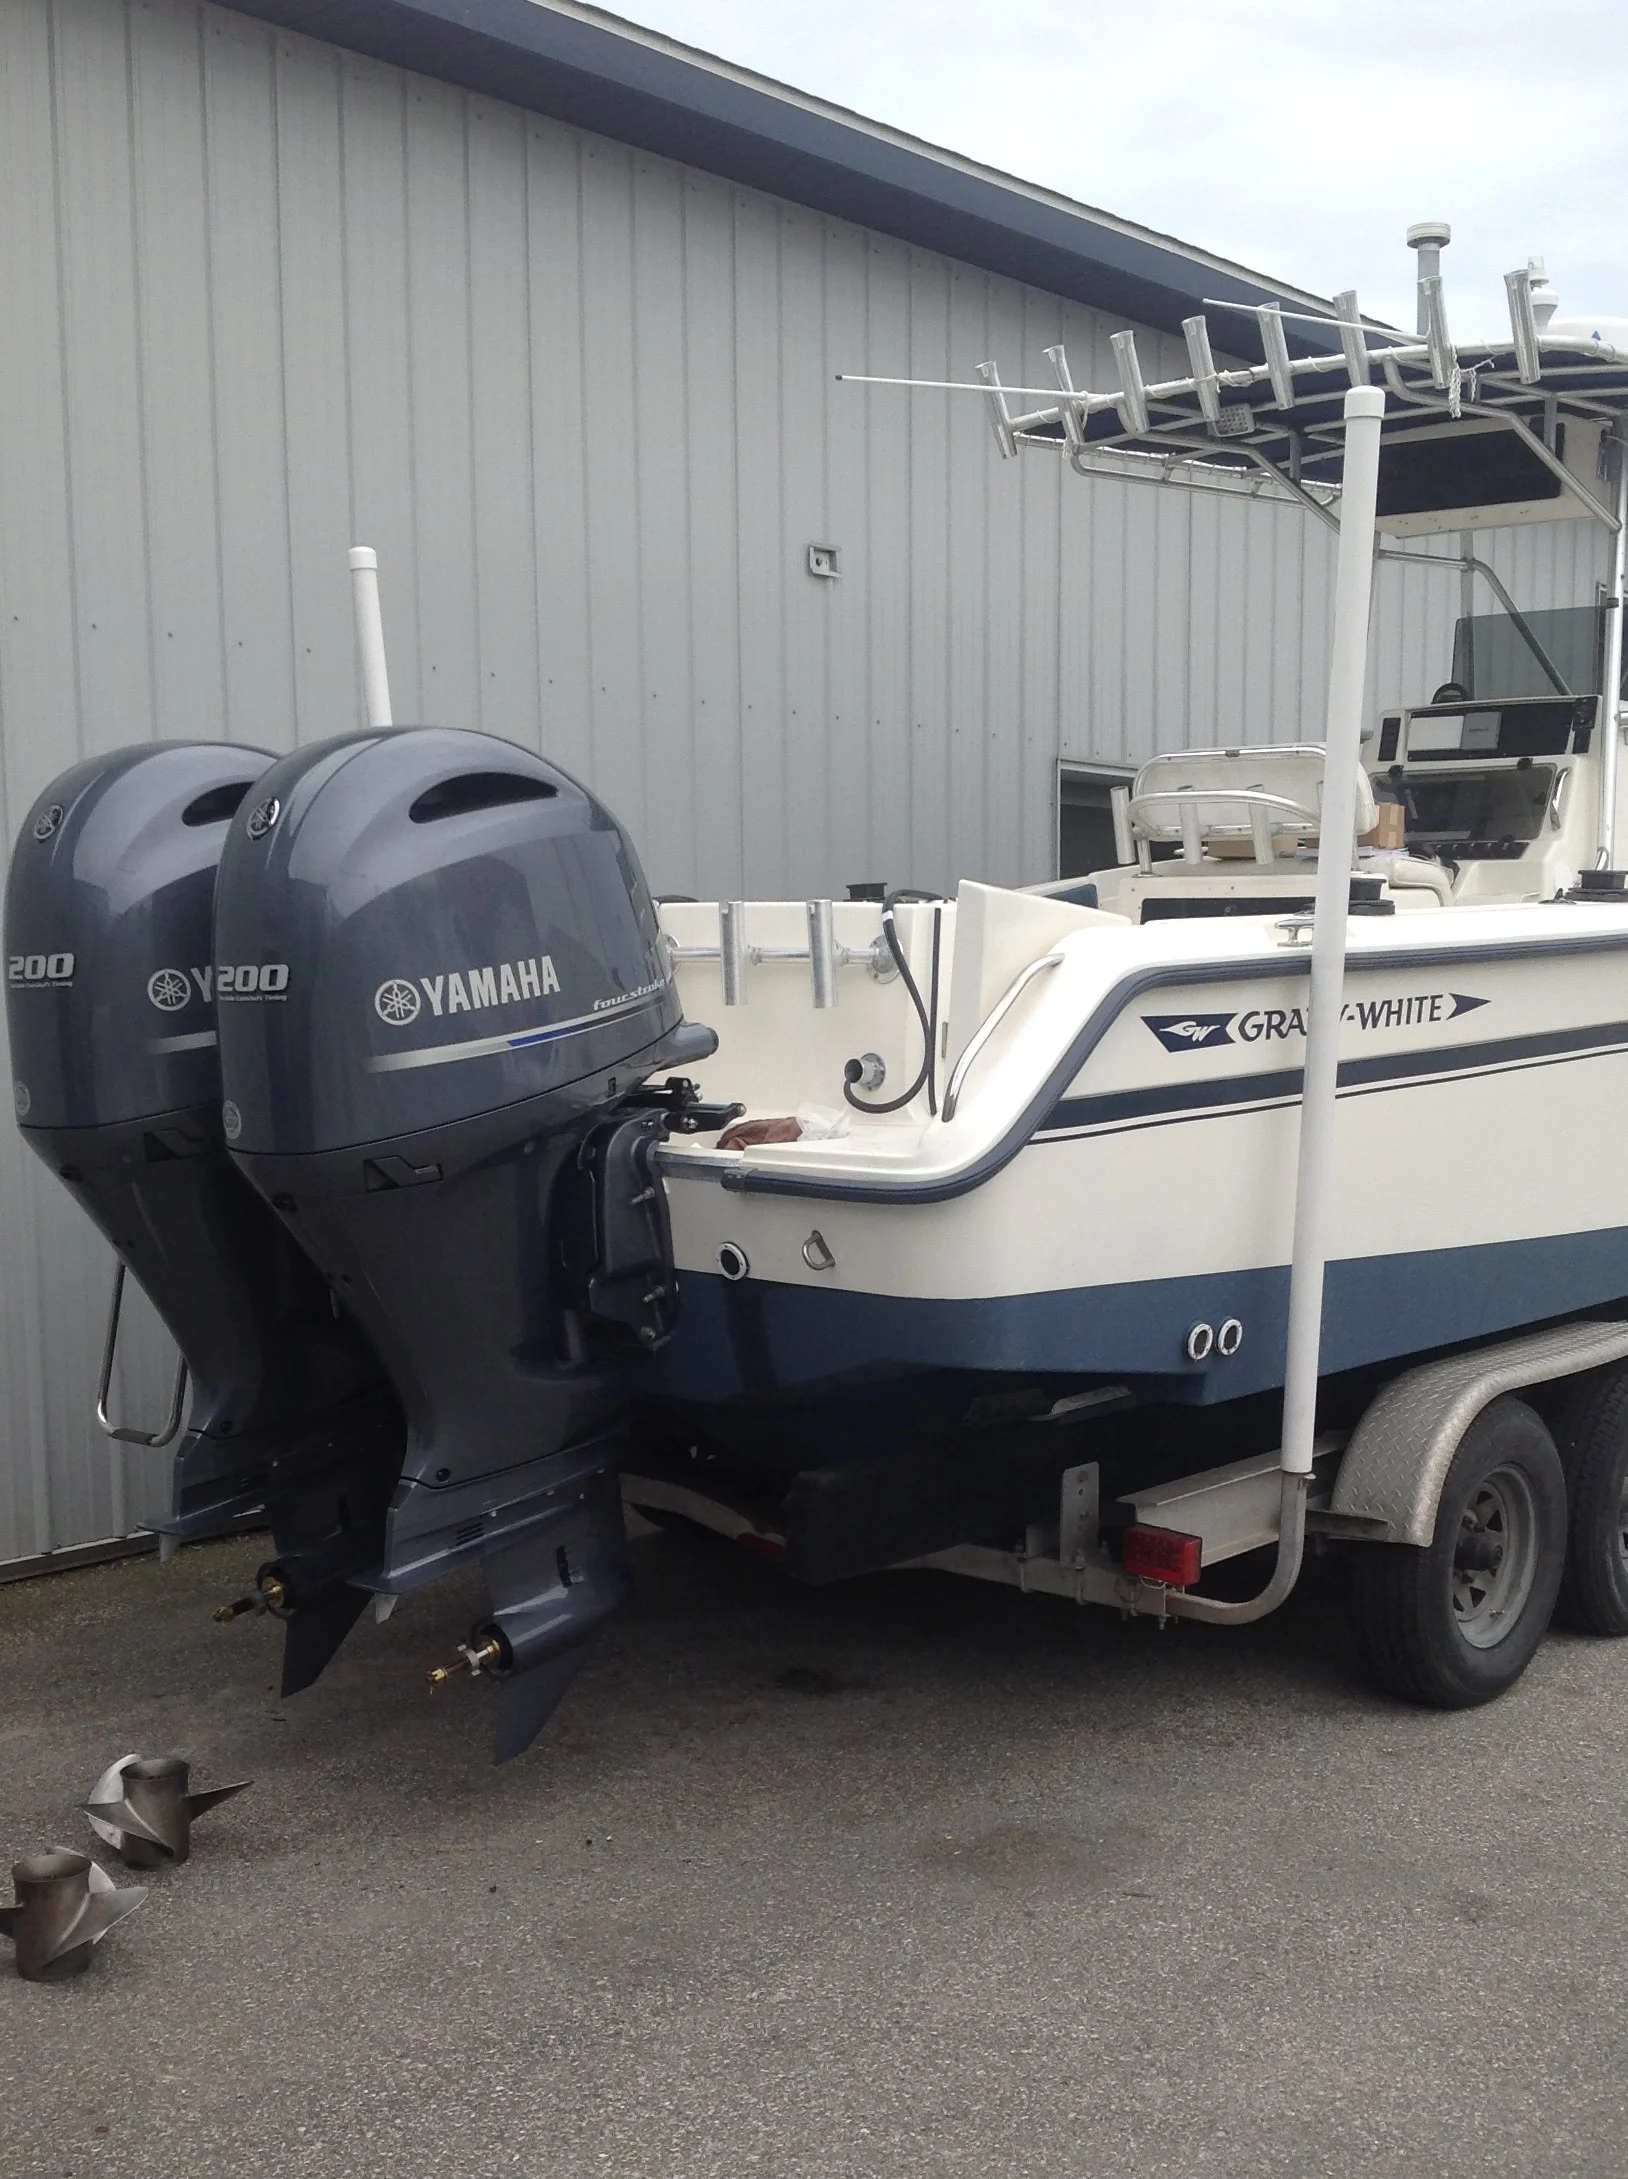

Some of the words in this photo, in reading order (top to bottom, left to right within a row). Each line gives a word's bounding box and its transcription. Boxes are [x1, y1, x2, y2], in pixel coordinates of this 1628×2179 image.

[8, 953, 75, 980] 200
[217, 964, 289, 992] 200
[420, 955, 561, 1016] YAMAHA
[1238, 994, 1443, 1042] GRA-WHITE
